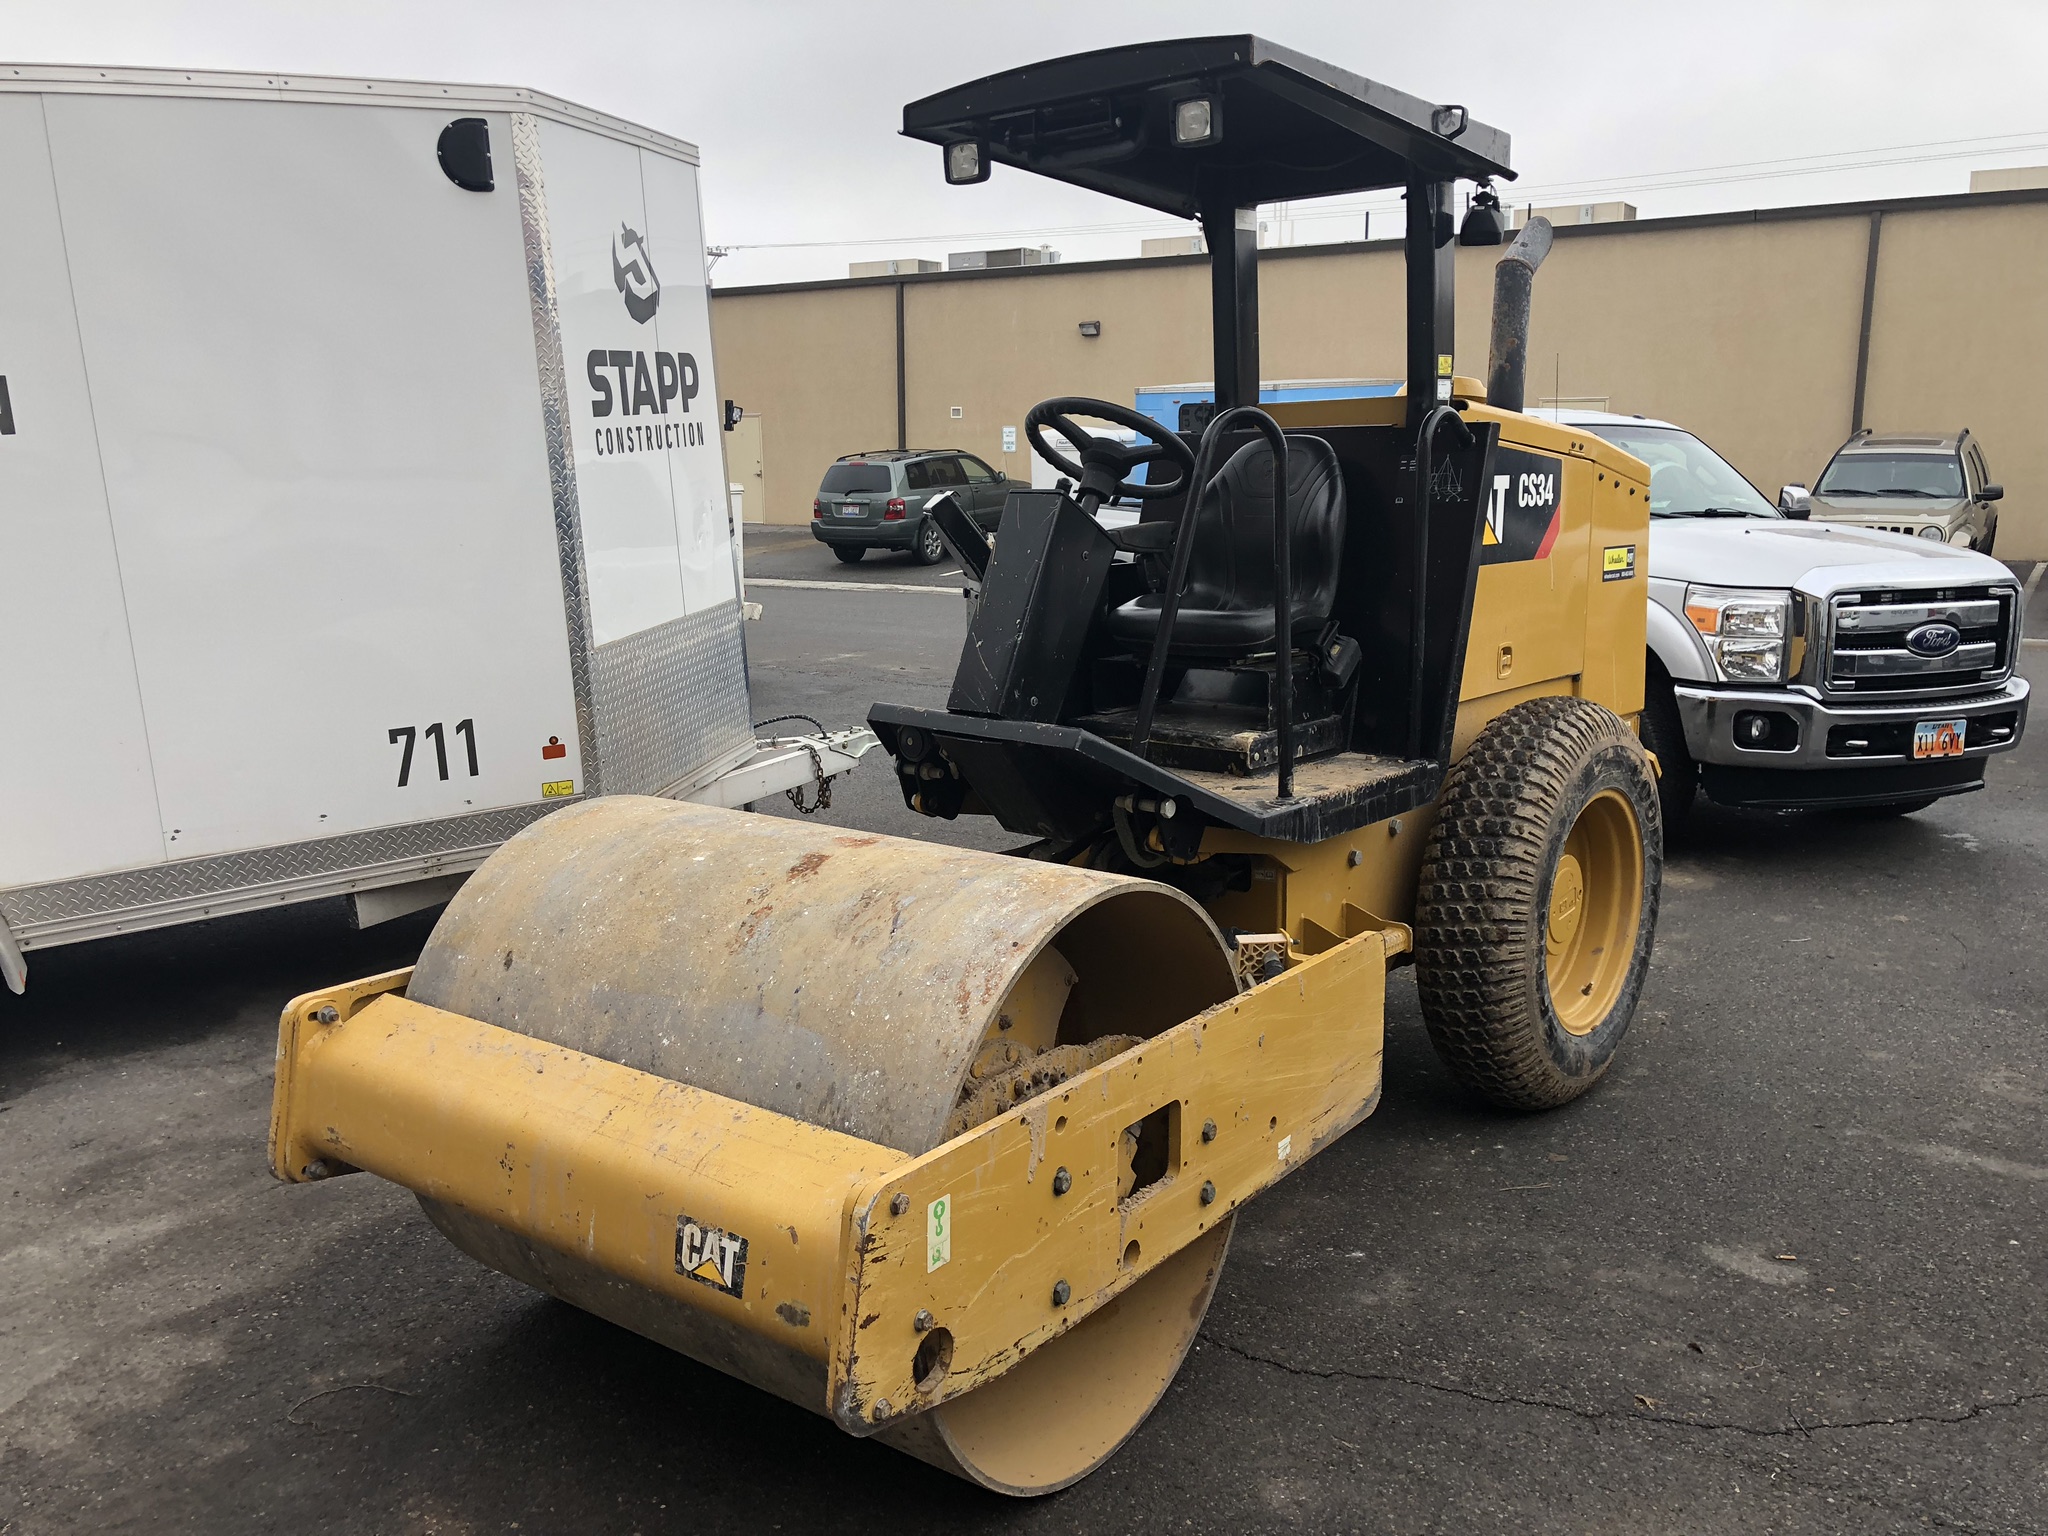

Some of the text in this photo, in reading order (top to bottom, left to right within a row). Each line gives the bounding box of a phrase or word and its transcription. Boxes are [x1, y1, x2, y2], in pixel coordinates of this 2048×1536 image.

[586, 349, 699, 417] STAPP
[595, 422, 704, 455] CONSTRUCTION
[1518, 473, 1554, 508] CS34
[1922, 629, 1952, 648] Ford
[388, 718, 480, 788] 711
[1917, 732, 1962, 752] X11 6VY
[682, 1223, 741, 1289] CAT
